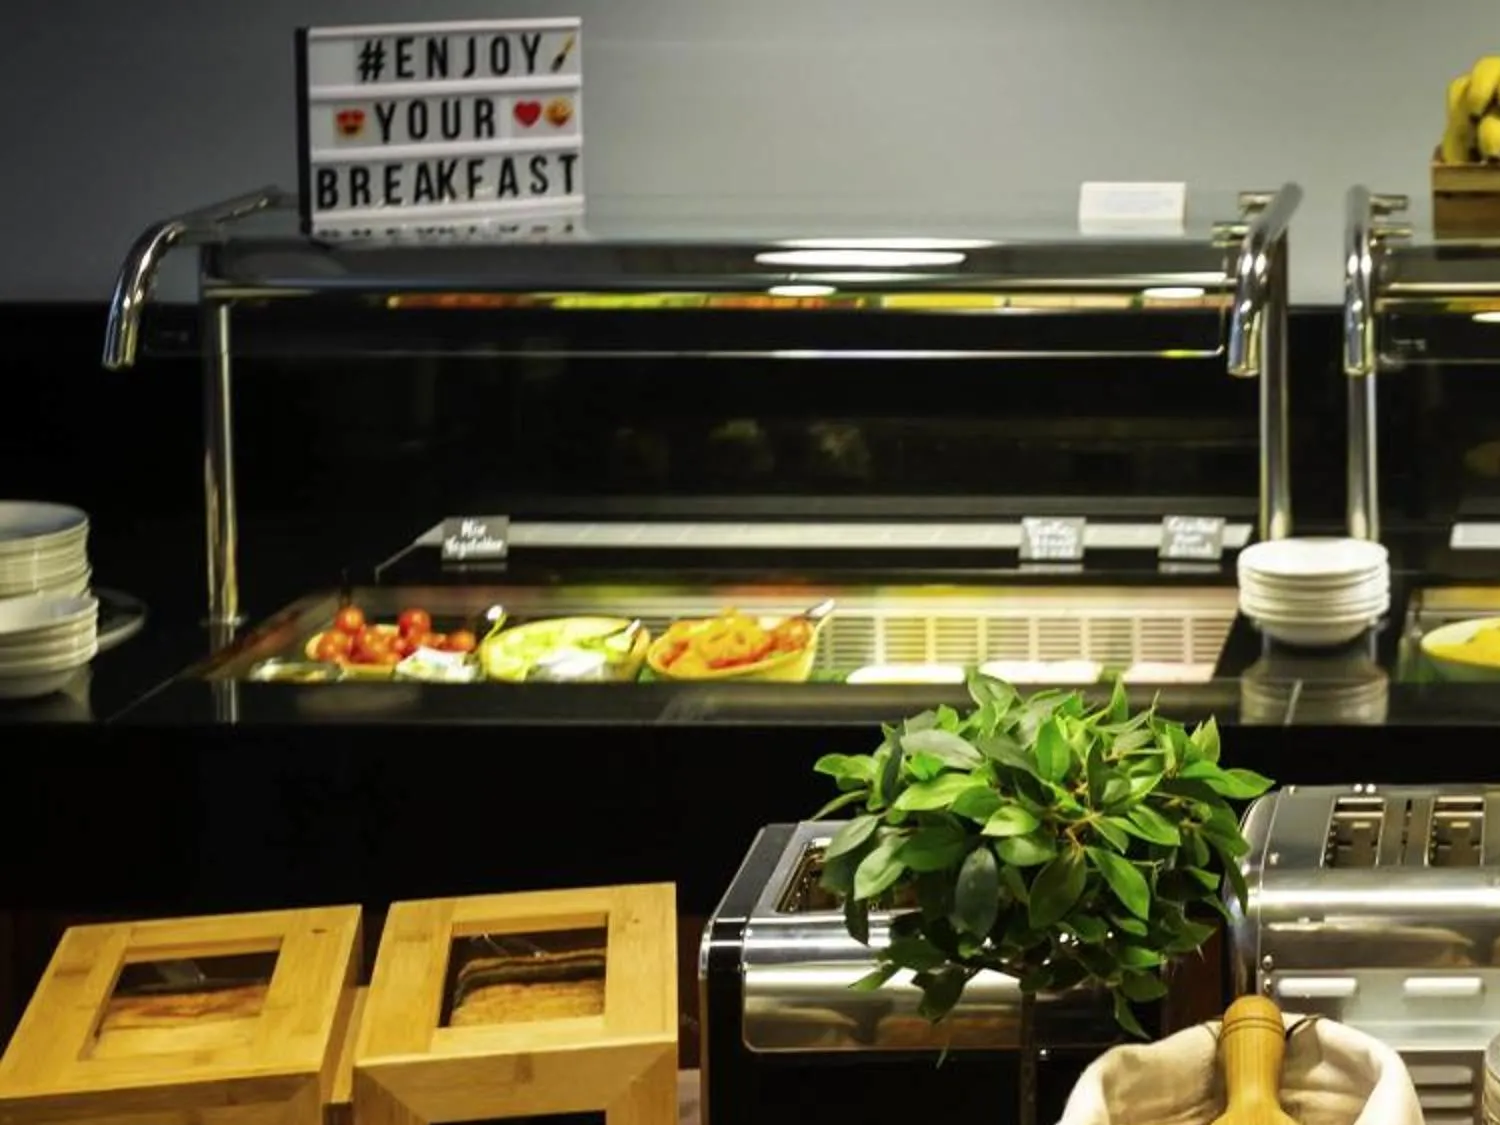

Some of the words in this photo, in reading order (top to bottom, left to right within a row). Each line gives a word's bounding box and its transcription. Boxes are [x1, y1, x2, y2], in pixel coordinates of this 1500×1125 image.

[357, 32, 542, 84] #ENJOY
[375, 97, 495, 143] YOUR
[316, 153, 578, 210] BREAKFAST
